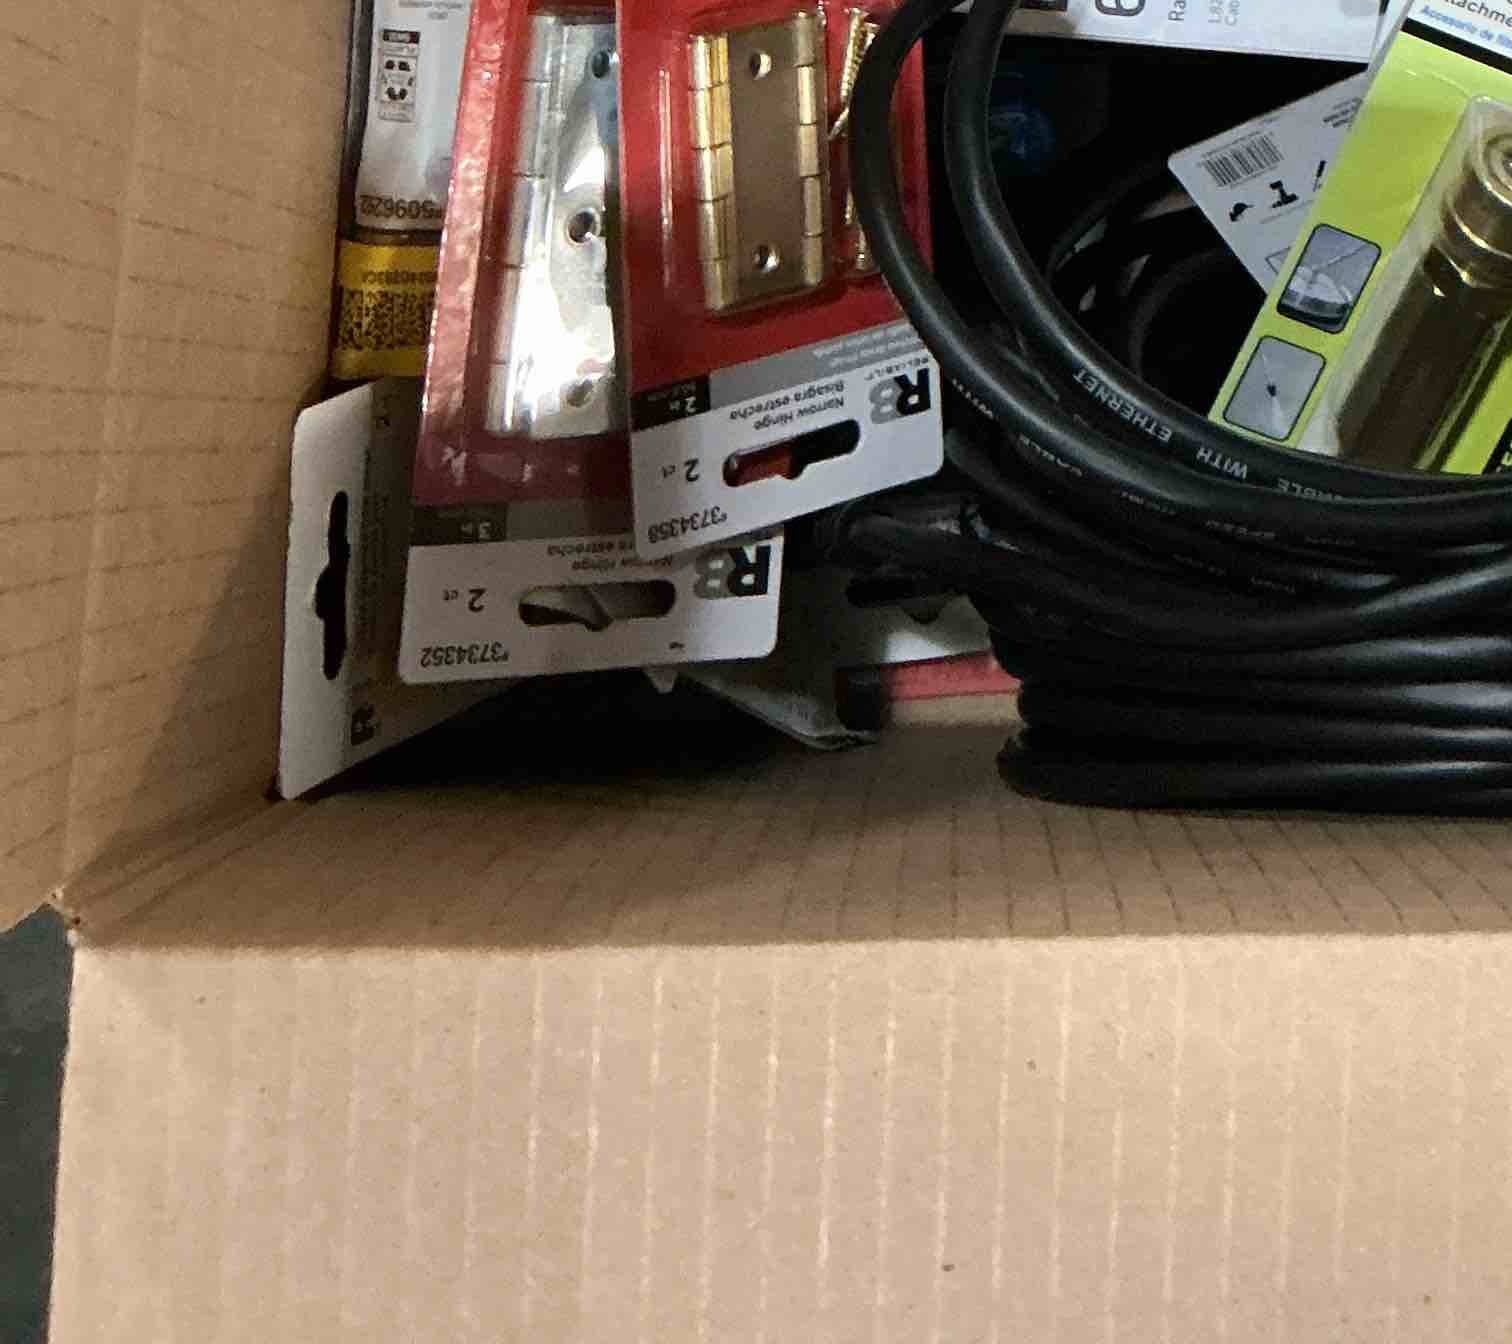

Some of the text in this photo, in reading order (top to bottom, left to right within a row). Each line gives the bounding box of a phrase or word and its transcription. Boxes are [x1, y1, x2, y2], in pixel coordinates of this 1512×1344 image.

[729, 379, 846, 421] Bisagra estrecha
[797, 396, 846, 418] Narrow
[1073, 368, 1173, 443] ETHERNET
[684, 458, 700, 482] 2
[1196, 446, 1248, 480] WITH
[467, 588, 486, 613] 2
